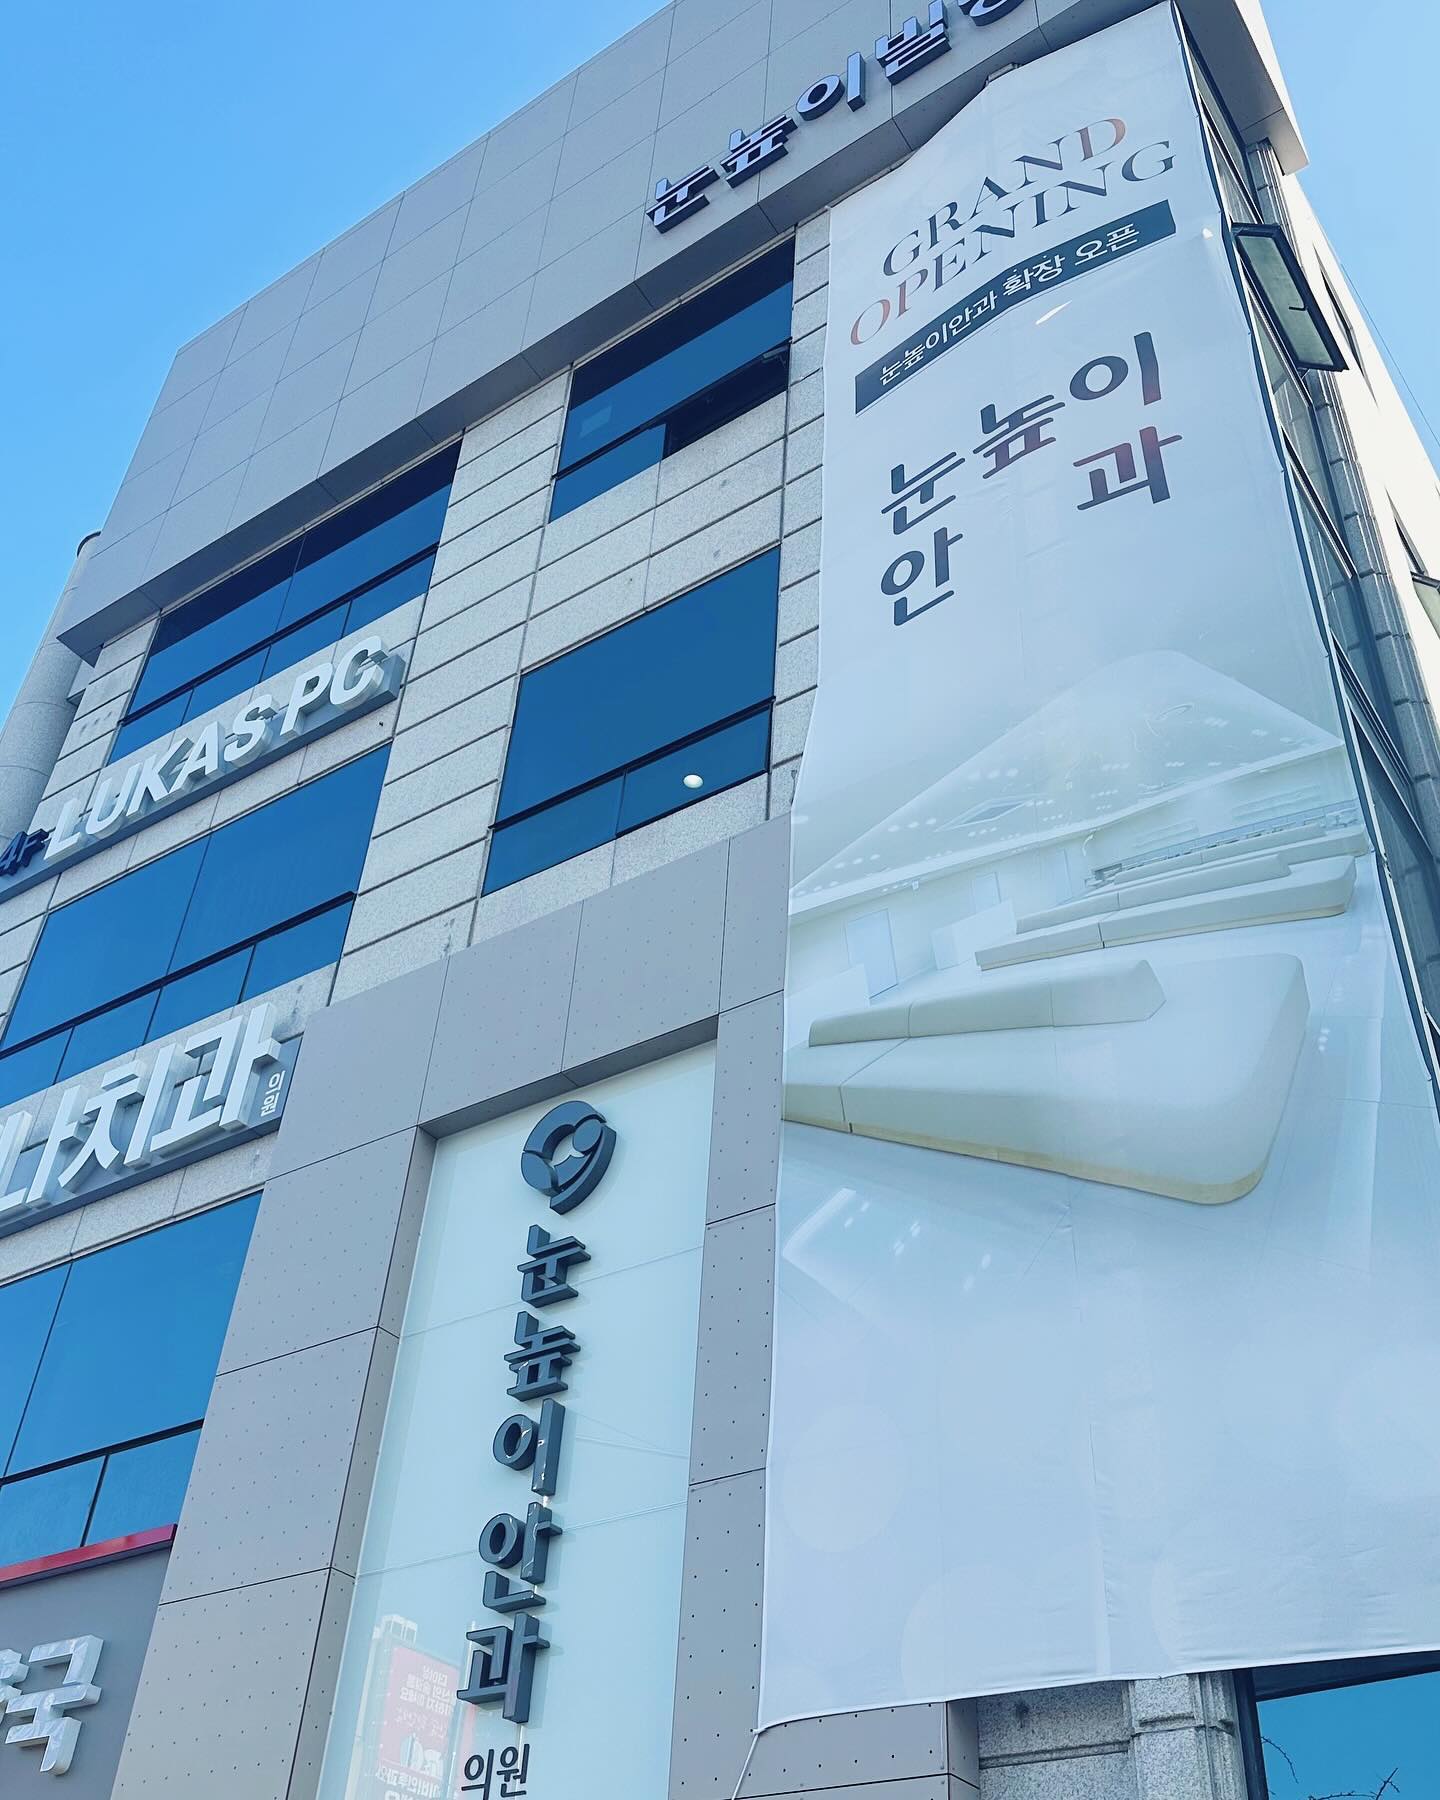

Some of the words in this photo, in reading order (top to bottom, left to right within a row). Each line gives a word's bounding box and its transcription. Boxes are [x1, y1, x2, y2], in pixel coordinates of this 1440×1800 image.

[850, 141, 1177, 346] OPENING
[883, 118, 1126, 276] GRAND
[880, 290, 998, 386] 눈높이안과
[1075, 223, 1140, 266] 오픈
[881, 331, 1162, 536] 눈높이
[43, 693, 280, 868] LUKAS
[279, 634, 393, 740] PC
[261, 1070, 286, 1117] 의원
[457, 1224, 593, 1725] 눈높이안과
[461, 1743, 530, 1800] 의원
